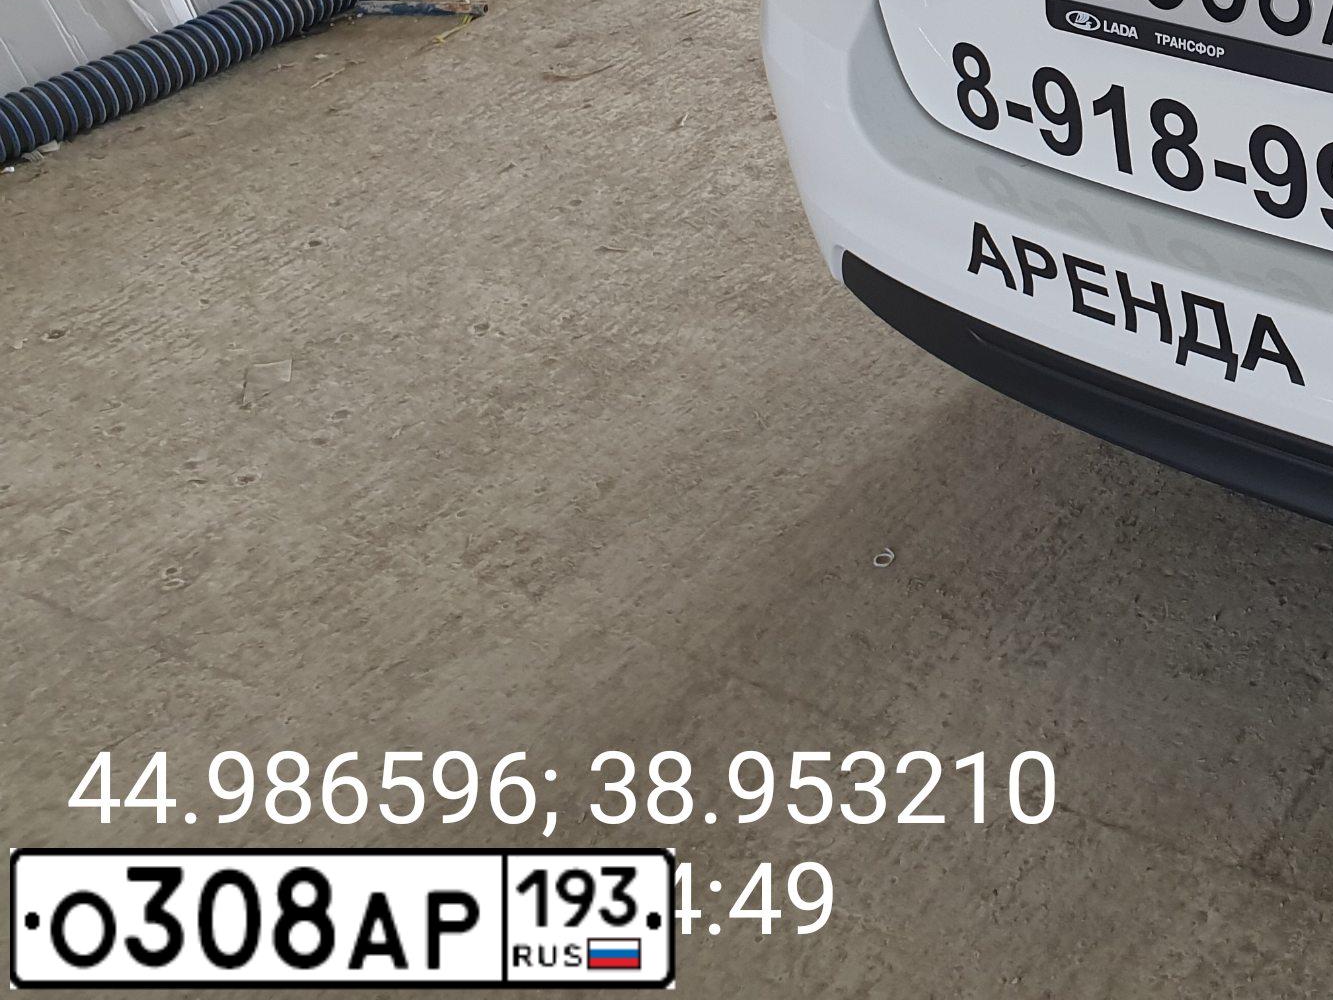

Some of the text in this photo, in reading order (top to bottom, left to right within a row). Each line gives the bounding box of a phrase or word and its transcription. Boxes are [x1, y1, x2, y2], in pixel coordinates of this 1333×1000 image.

[1103, 19, 1225, 59] LADA ТРАНСФОР
[966, 221, 1306, 387] АРЕНДА
